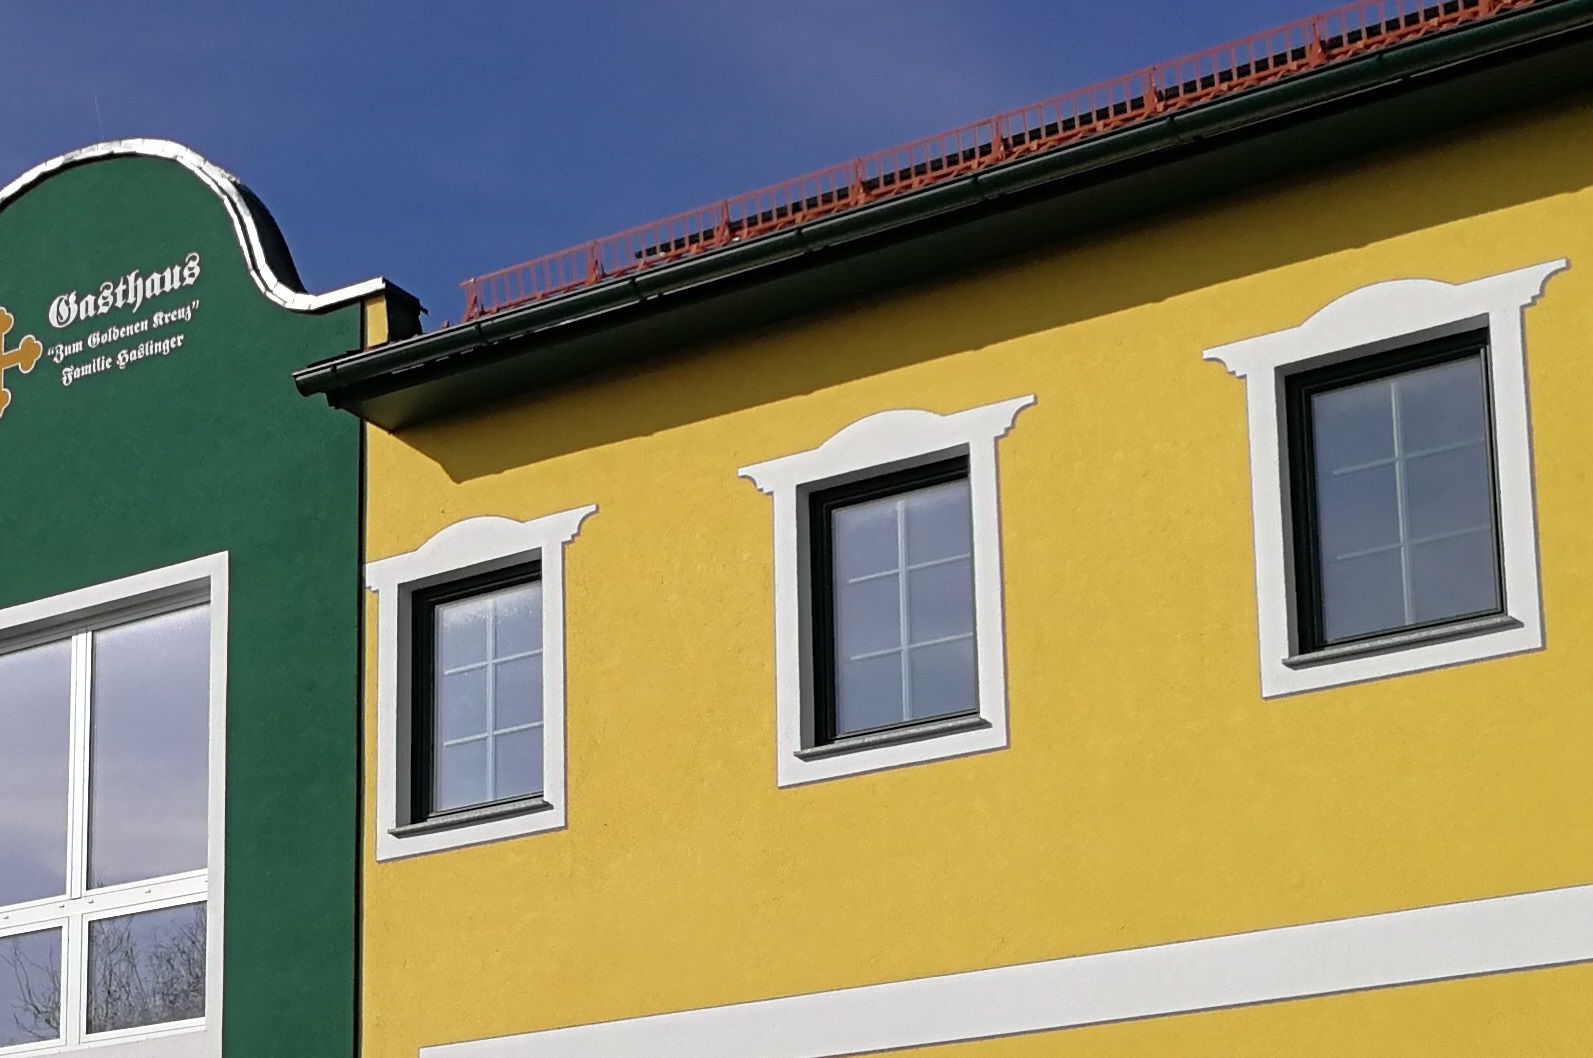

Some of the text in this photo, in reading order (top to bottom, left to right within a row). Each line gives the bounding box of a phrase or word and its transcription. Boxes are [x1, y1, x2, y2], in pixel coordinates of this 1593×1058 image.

[48, 252, 200, 328] Gasthaus
[61, 333, 184, 386] Familie Haslinger
[87, 317, 148, 349] Goldenen
